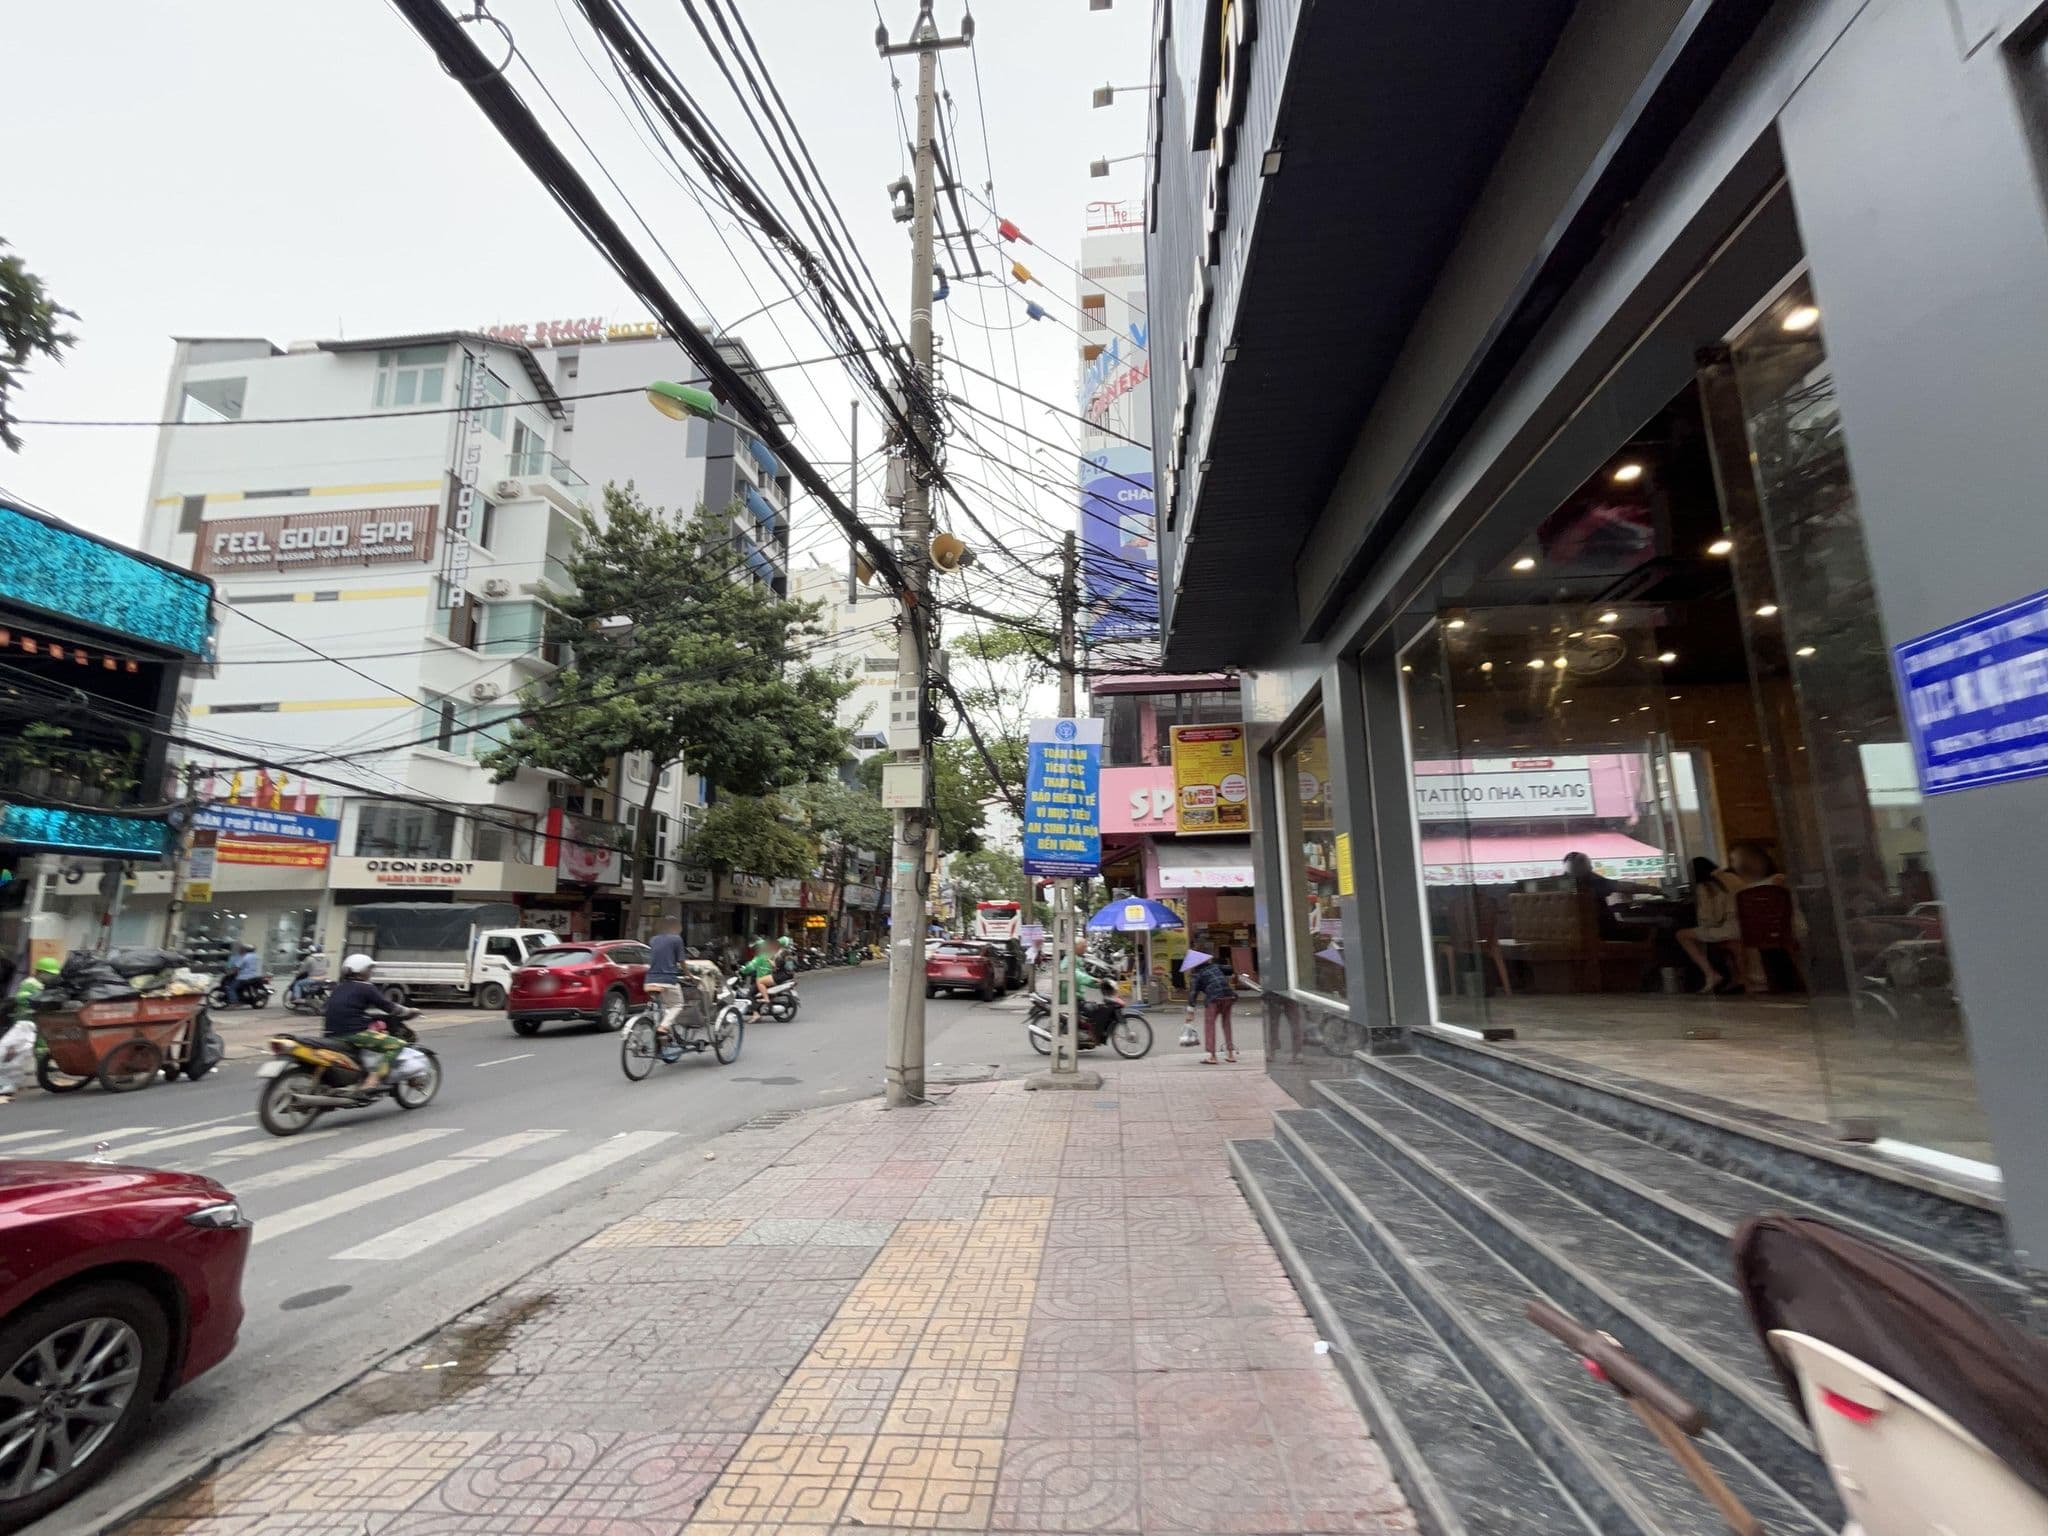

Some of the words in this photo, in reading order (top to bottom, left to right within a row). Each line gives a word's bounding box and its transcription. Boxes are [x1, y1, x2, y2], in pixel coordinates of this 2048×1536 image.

[1087, 200, 1127, 231] The
[214, 531, 271, 554] FEEL
[279, 525, 349, 549] GOOD
[361, 521, 414, 544] SPA
[1416, 787, 1483, 803] TATTOO
[421, 862, 474, 874] SPORT
